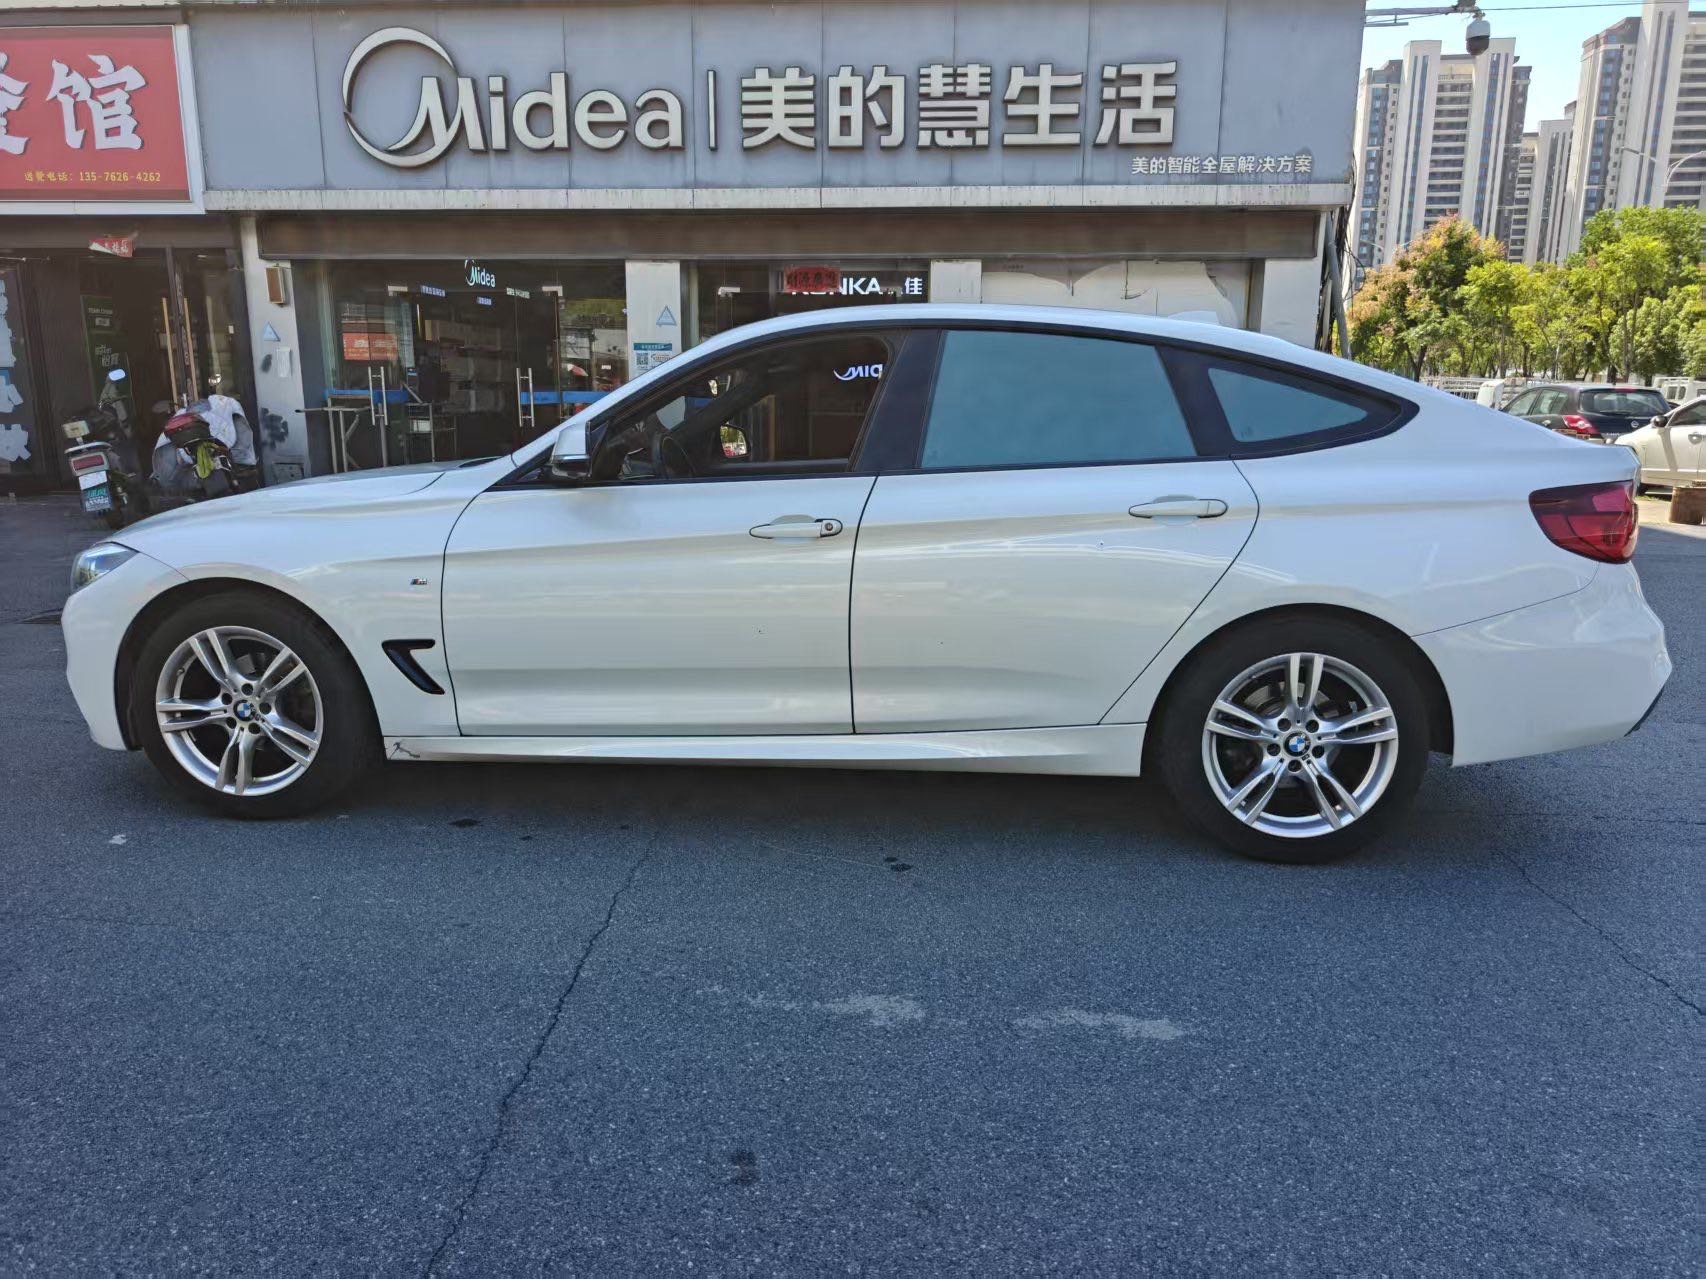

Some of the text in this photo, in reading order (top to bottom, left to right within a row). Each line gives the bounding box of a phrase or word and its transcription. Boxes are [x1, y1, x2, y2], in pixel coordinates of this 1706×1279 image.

[343, 60, 1178, 169] Midea 美的慧生活
[1131, 154, 1313, 174] 美的智能全屋解决方案
[466, 266, 496, 288] Midea
